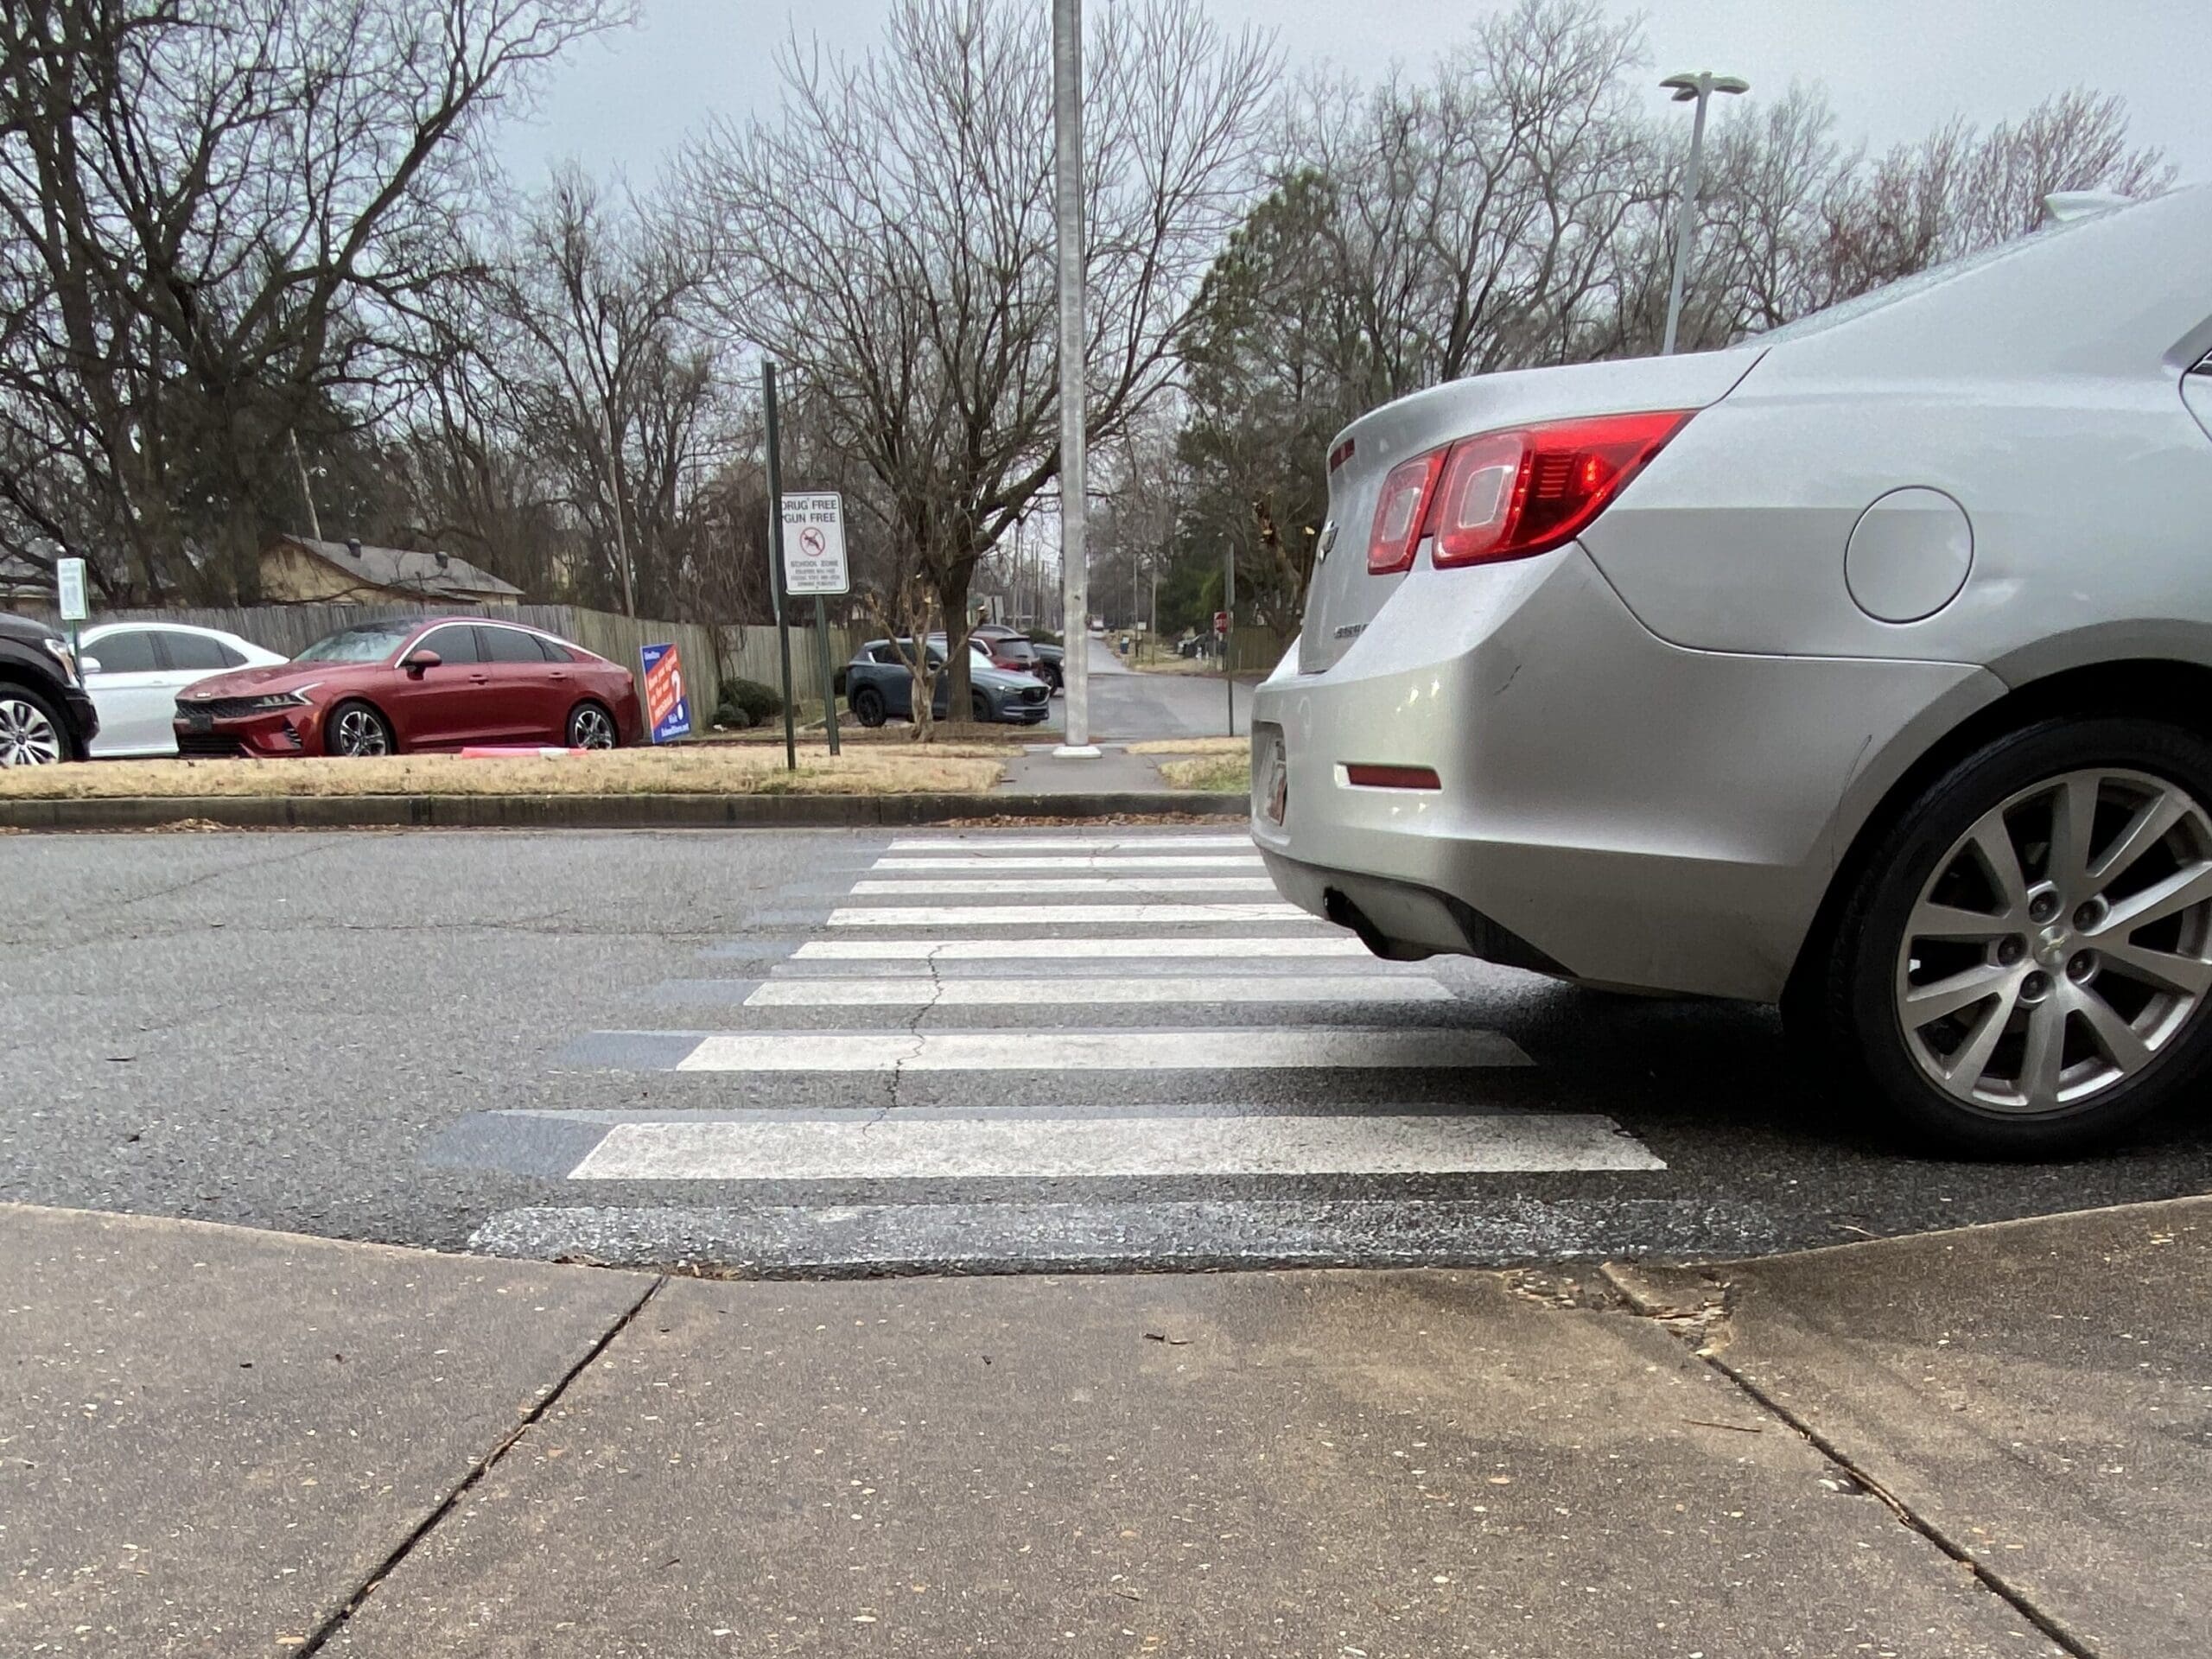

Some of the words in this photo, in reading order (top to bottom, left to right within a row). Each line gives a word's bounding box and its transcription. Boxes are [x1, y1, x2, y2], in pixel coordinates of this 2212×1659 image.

[782, 500, 809, 511] DRUG
[812, 499, 837, 510] FREE
[784, 513, 806, 524] GUN
[810, 512, 836, 523] FREE
